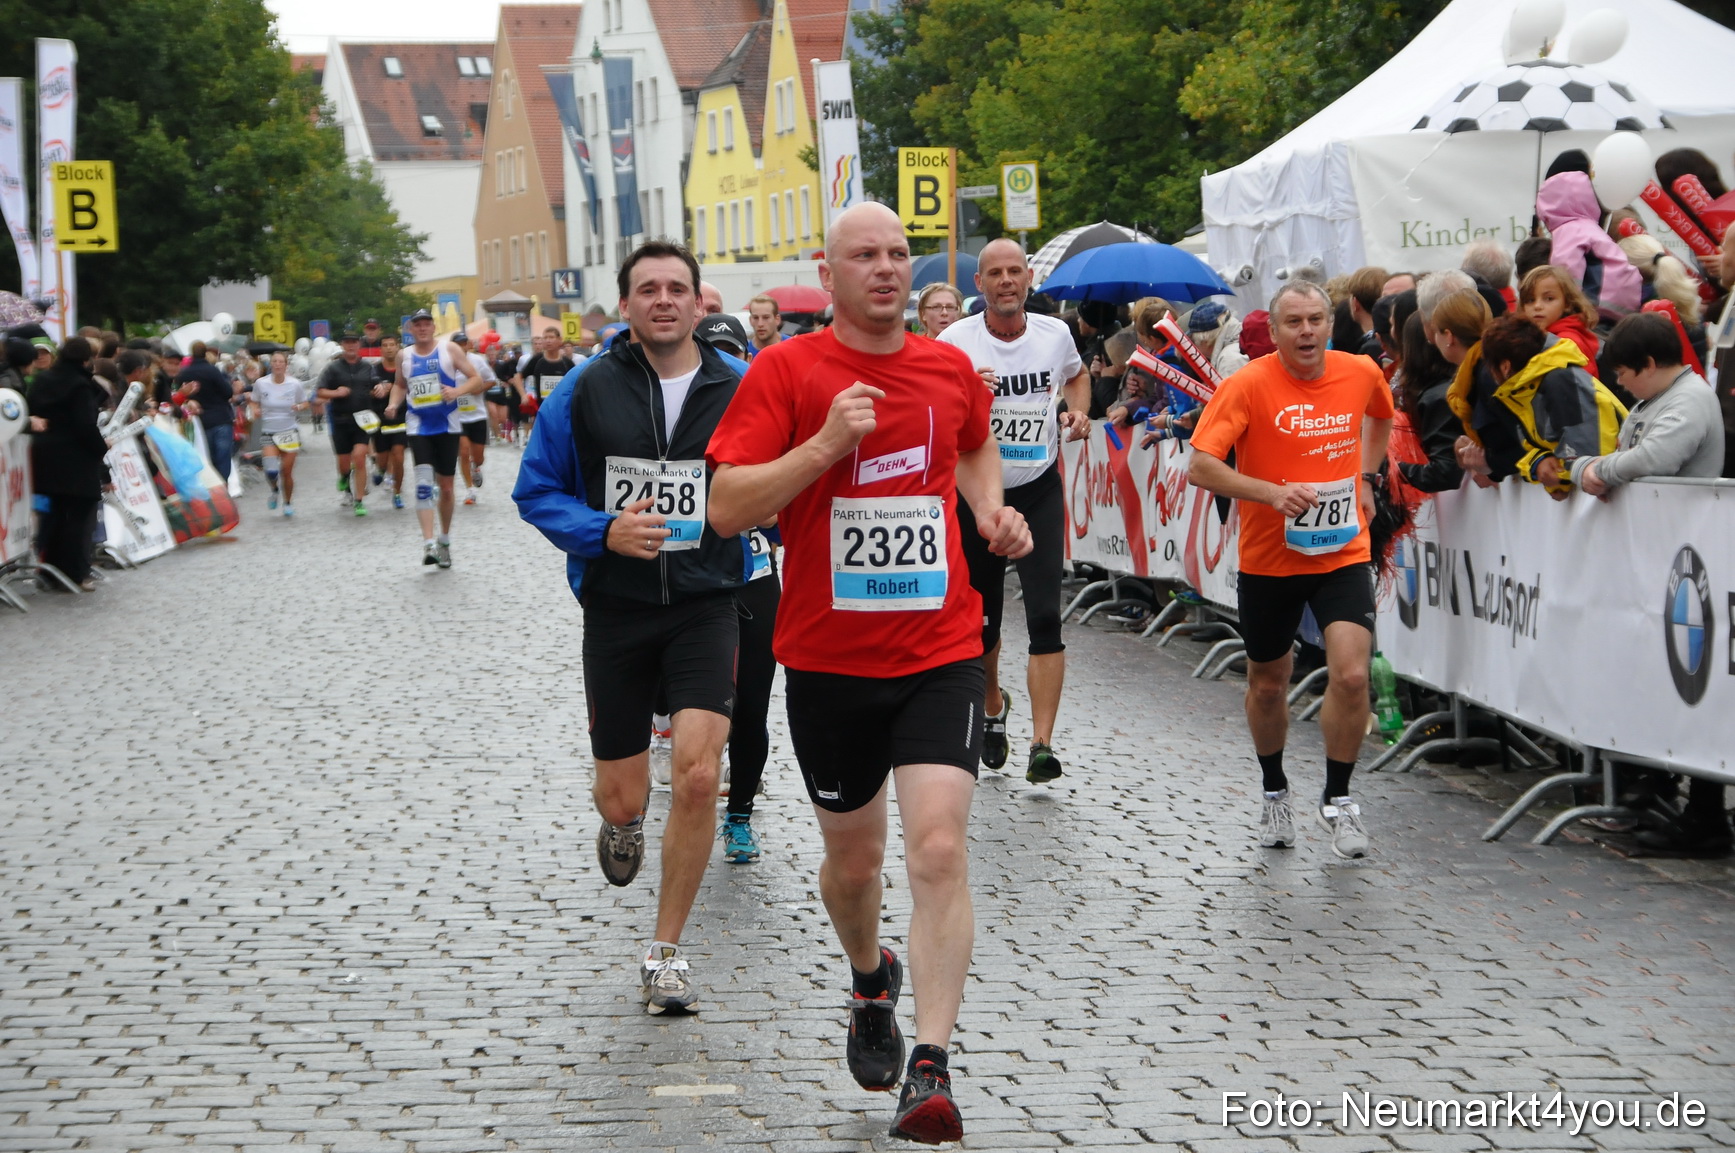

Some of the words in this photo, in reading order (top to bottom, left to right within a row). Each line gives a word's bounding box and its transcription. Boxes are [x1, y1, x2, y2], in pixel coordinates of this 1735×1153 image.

[905, 151, 949, 167] Block
[57, 164, 104, 180] Block
[914, 174, 941, 216] B
[69, 188, 98, 230] B
[1401, 217, 1501, 248] Kinder
[260, 312, 274, 331] C
[566, 321, 577, 336] D
[994, 371, 1050, 396] HULE
[990, 408, 1008, 416] ARTL
[990, 418, 1045, 442] 2427
[1290, 413, 1353, 430] Fischer
[1297, 425, 1350, 437] AUTOMOBILE
[1000, 447, 1033, 458] Richard
[608, 464, 640, 476] PARTL
[642, 468, 688, 478] Neumarkt
[877, 457, 908, 474] DEHN
[615, 479, 696, 516] 2458
[1316, 487, 1348, 498] Neumarkt
[833, 509, 872, 521] PARTL
[874, 508, 927, 520] Neumarkt
[1294, 496, 1352, 528] 2787
[843, 524, 938, 568] 2328
[1311, 533, 1338, 546] Erwin
[866, 578, 920, 595] Robert
